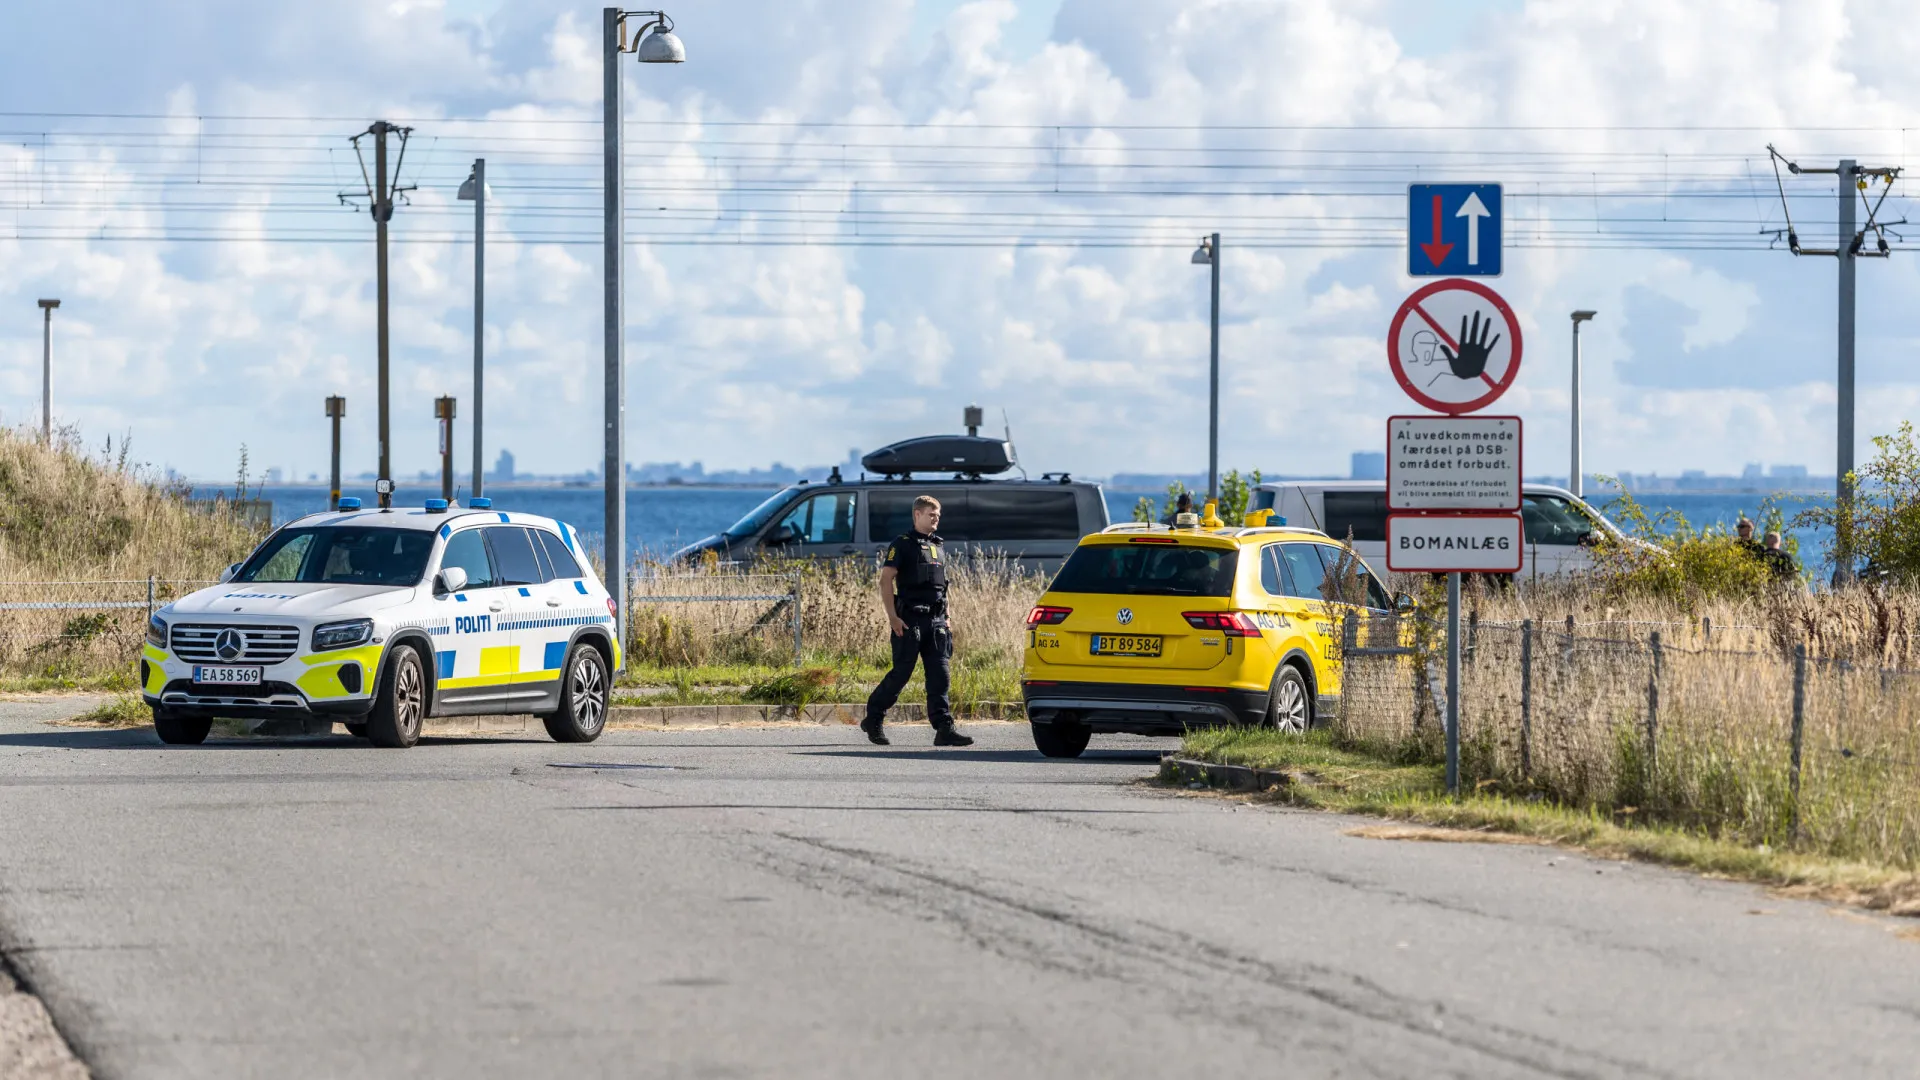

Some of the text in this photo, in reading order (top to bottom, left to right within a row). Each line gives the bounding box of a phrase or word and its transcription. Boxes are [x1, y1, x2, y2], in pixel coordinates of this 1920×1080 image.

[1397, 430, 1513, 440] Al uvedkommende
[1402, 445, 1508, 456] færdsel på DSB-
[1399, 459, 1511, 469] området forbudt.
[1402, 479, 1507, 487] Overtrædelse af forbudet
[1432, 490, 1465, 498] anmeldt
[1478, 490, 1512, 498] politiet.
[1400, 536, 1510, 550] BOMANLÆG
[455, 614, 491, 634] POLITI
[1256, 611, 1291, 629] AG 24
[1038, 639, 1060, 648] AG 24
[1099, 637, 1159, 651] BT 89 584
[202, 668, 258, 682] EA 58 569
